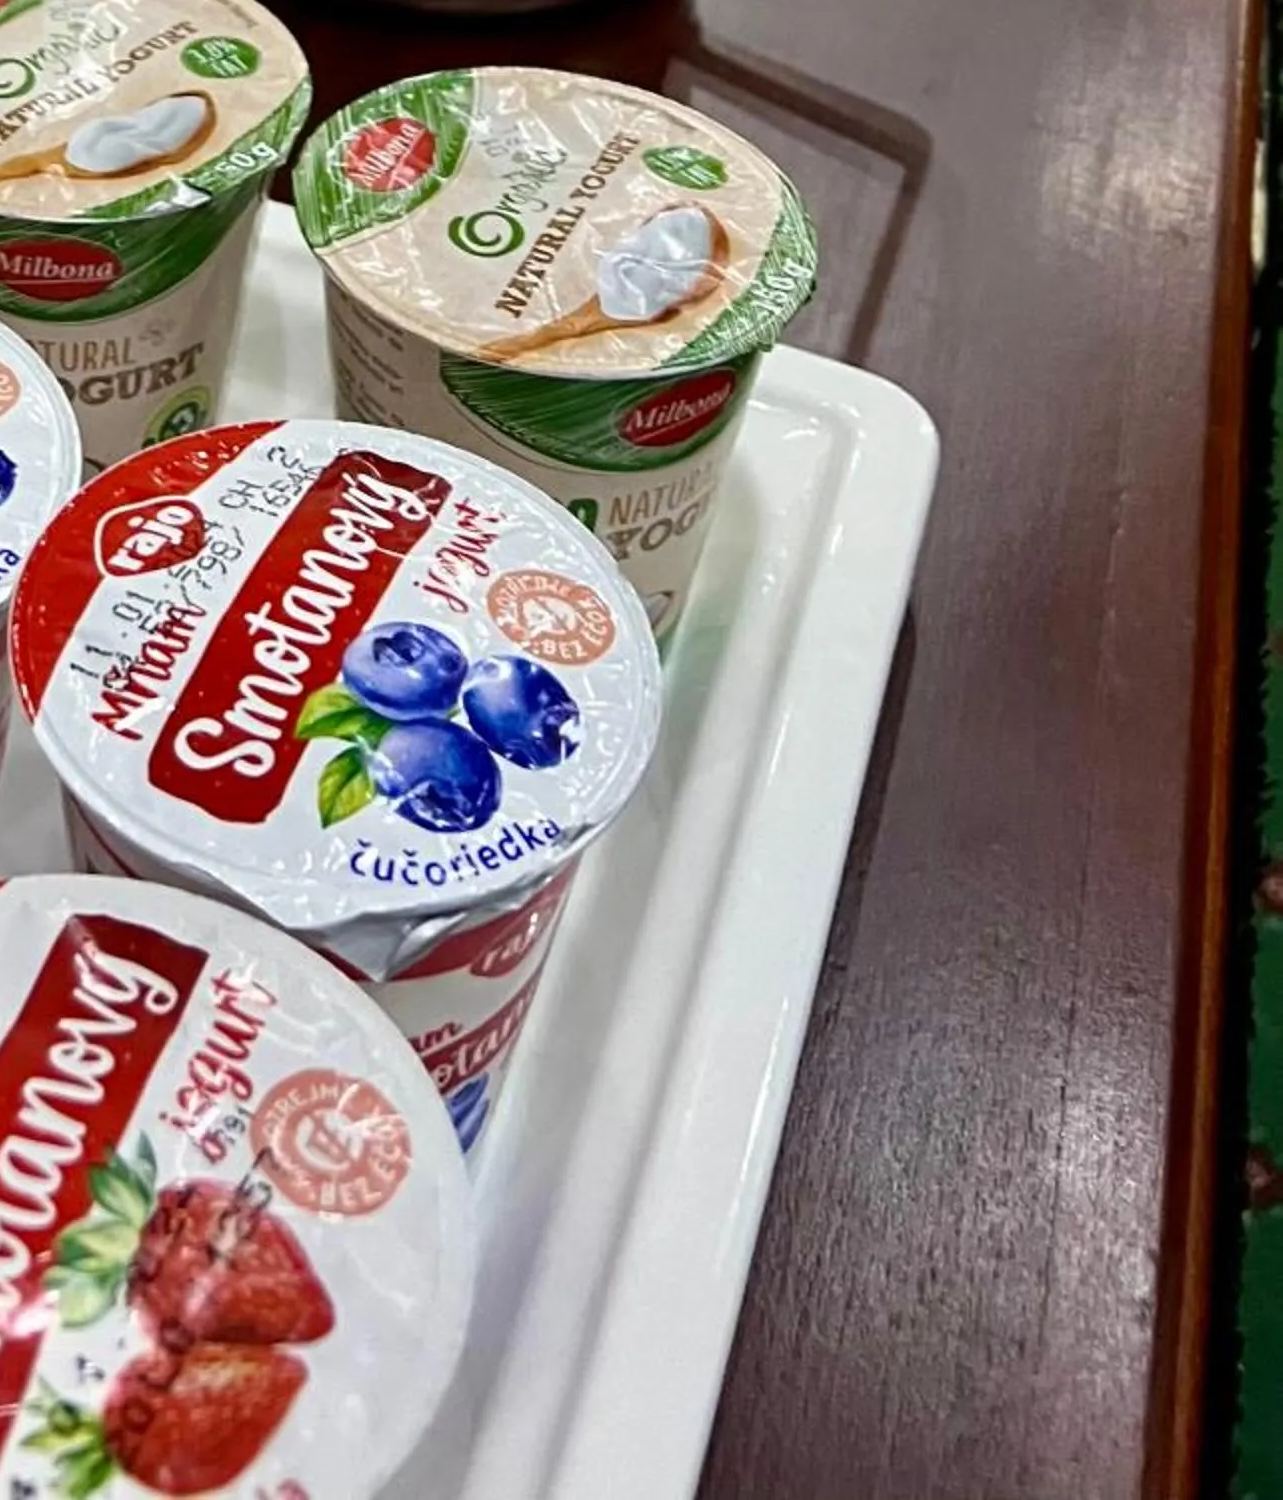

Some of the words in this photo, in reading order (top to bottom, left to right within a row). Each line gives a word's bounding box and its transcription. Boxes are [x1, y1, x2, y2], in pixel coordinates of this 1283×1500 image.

[495, 203, 587, 320] NATURAL
[569, 129, 641, 200] YOGURT
[27, 337, 138, 374] TURAL
[624, 381, 732, 433] Milbona
[107, 503, 195, 571] rajo
[174, 470, 428, 779] Smotanový
[349, 815, 562, 887] čučoriedka
